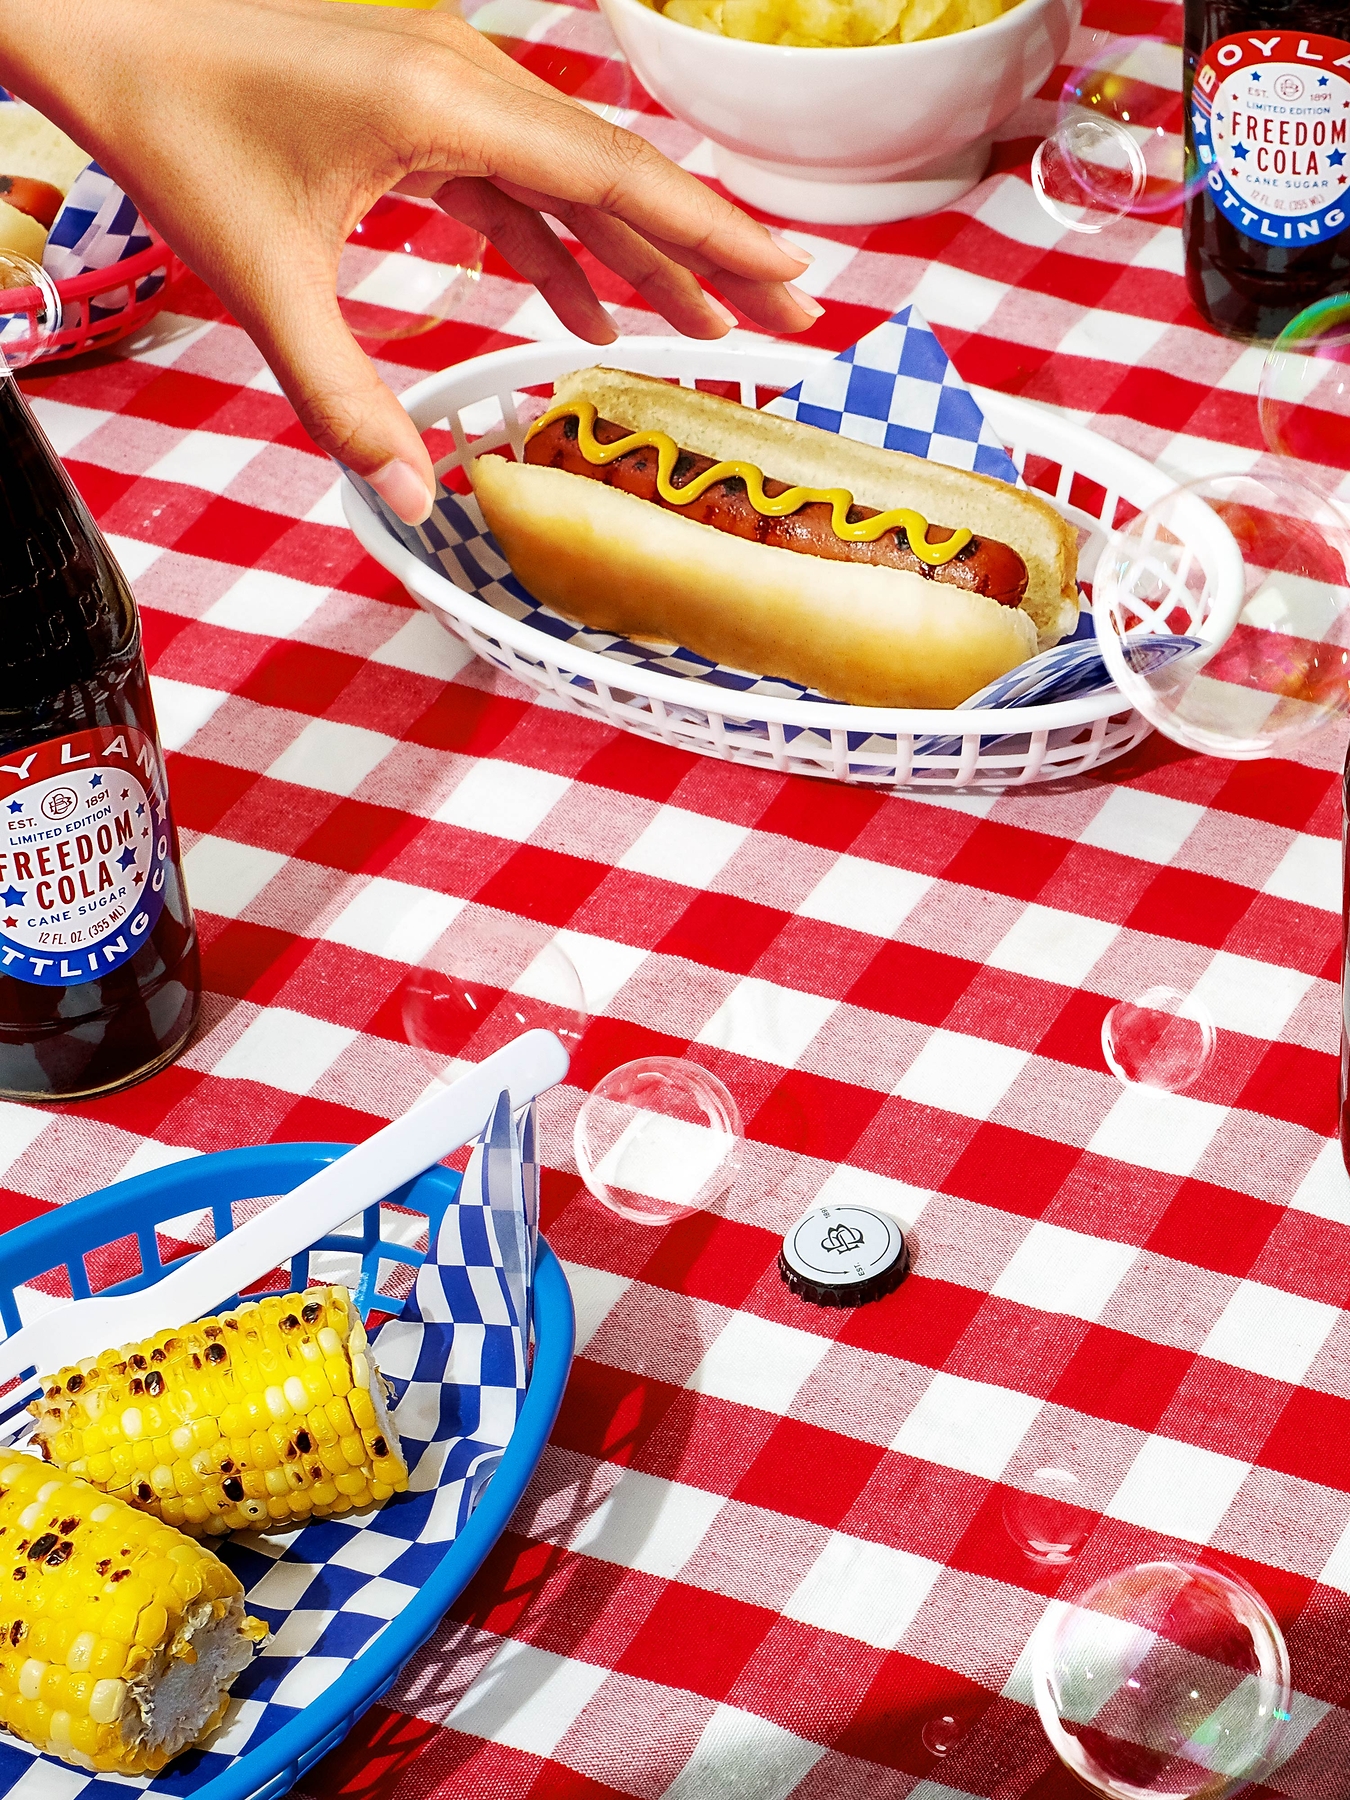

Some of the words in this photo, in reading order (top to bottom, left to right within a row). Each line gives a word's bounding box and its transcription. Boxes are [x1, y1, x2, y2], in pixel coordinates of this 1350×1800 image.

[1246, 102, 1286, 114] LIMITED
[1289, 106, 1331, 115] EDITION
[1248, 87, 1269, 98] EST.
[1310, 93, 1332, 102] 1891
[1232, 111, 1347, 146] FREEDOM
[1257, 147, 1319, 175] COLA
[1246, 175, 1278, 187] CANE
[1285, 180, 1328, 188] SUGAR
[0, 735, 156, 780] YLAN
[8, 818, 38, 830] EST.
[85, 788, 110, 809] 1891
[9, 827, 62, 846] LIMITED
[65, 805, 112, 833] EDITION
[37, 860, 114, 910] COLA
[0, 911, 149, 978] TTLING
[152, 835, 168, 893] CO
[27, 911, 71, 928] CANE
[78, 887, 127, 916] SUGAR
[38, 931, 50, 943] 12
[51, 932, 67, 945] FL.
[70, 929, 87, 943] OZ.
[88, 918, 110, 939] (355
[110, 905, 127, 924] ML)
